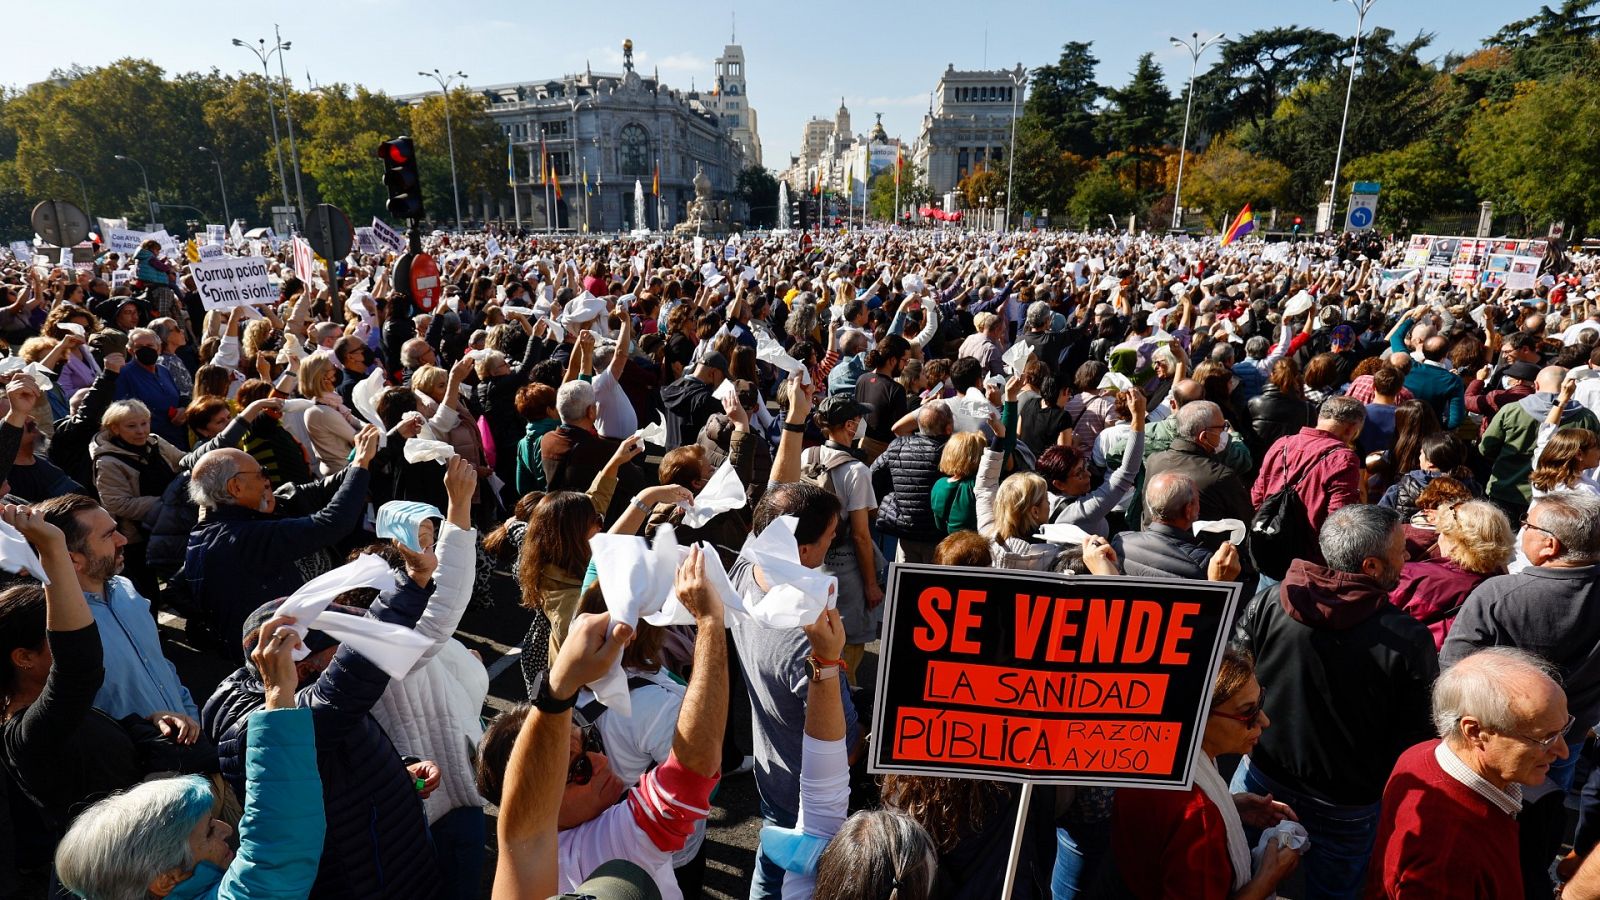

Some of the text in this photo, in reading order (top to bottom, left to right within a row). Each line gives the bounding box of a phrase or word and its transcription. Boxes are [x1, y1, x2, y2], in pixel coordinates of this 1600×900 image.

[195, 261, 267, 282] Corrup pción
[210, 286, 240, 302] Dimi
[241, 283, 272, 300] sión!
[913, 586, 1201, 665] SE VENDE
[928, 666, 976, 701] LA
[1067, 720, 1171, 743] RAZÓN:
[1062, 747, 1150, 772] AYUSO
